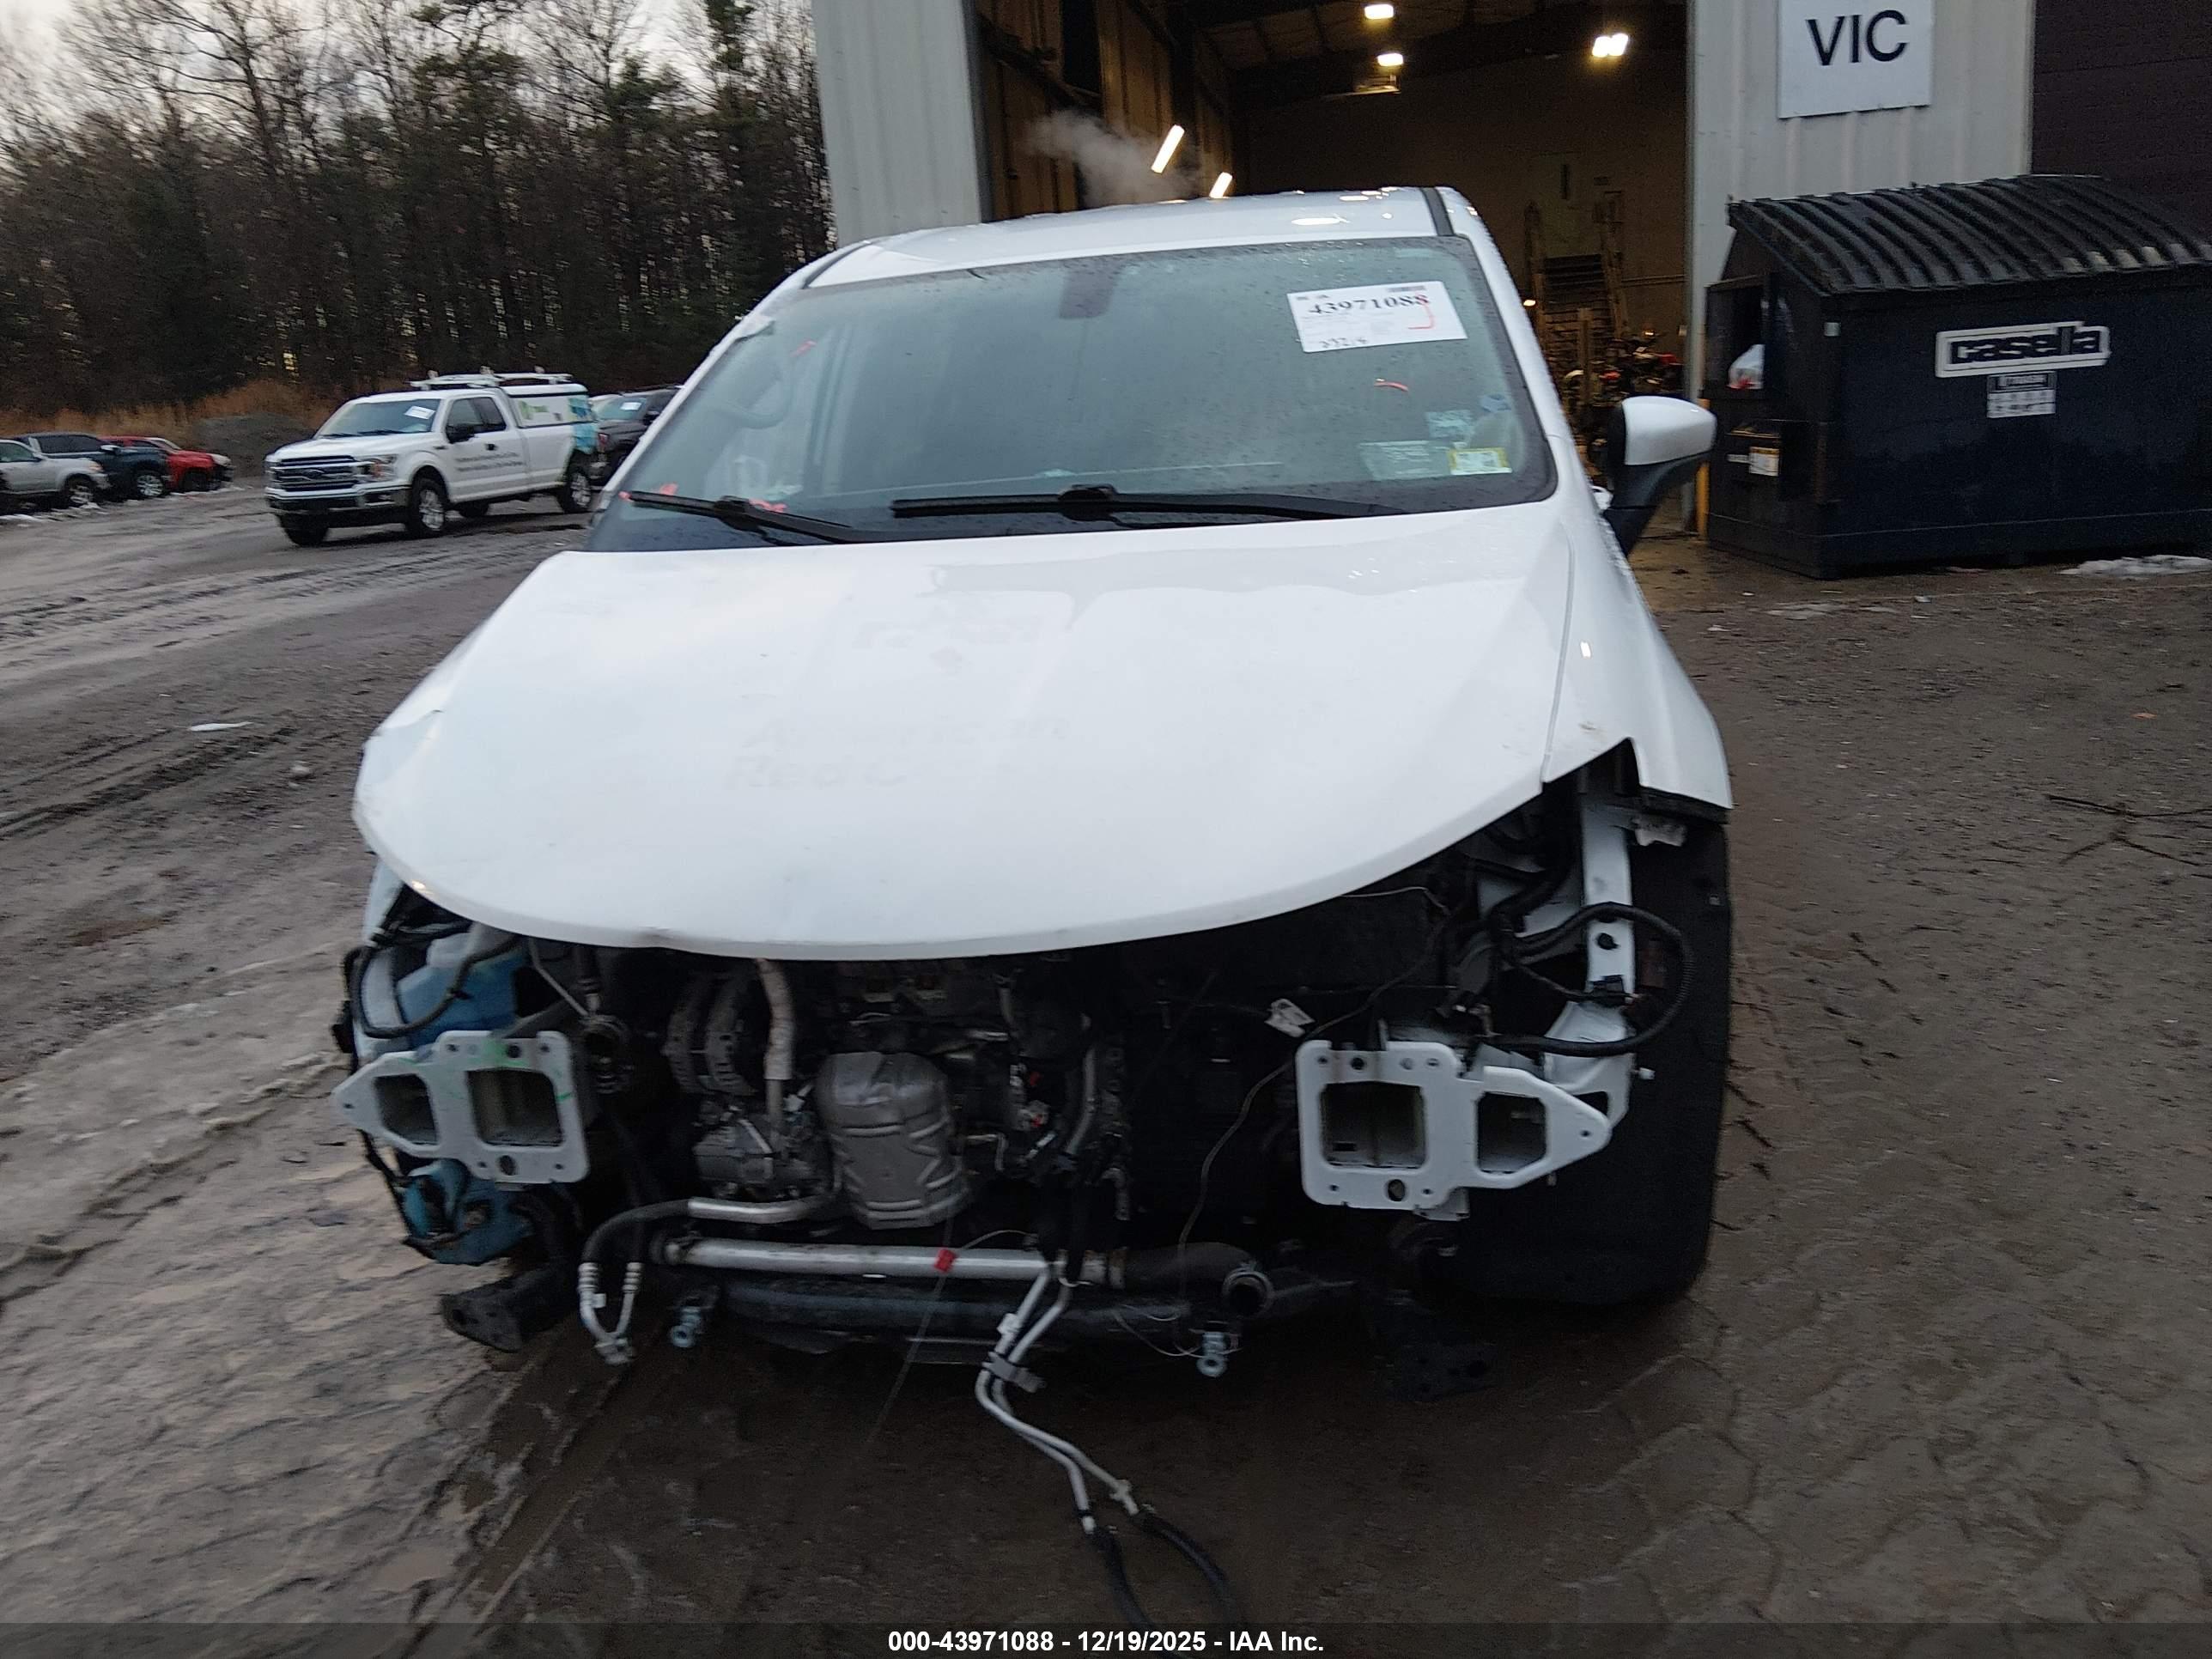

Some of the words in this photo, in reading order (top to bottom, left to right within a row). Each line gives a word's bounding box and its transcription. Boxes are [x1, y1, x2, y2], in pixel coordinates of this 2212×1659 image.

[1806, 9, 1909, 66] VIC
[1309, 294, 1429, 314] 43971088
[1951, 326, 2100, 364] casella
